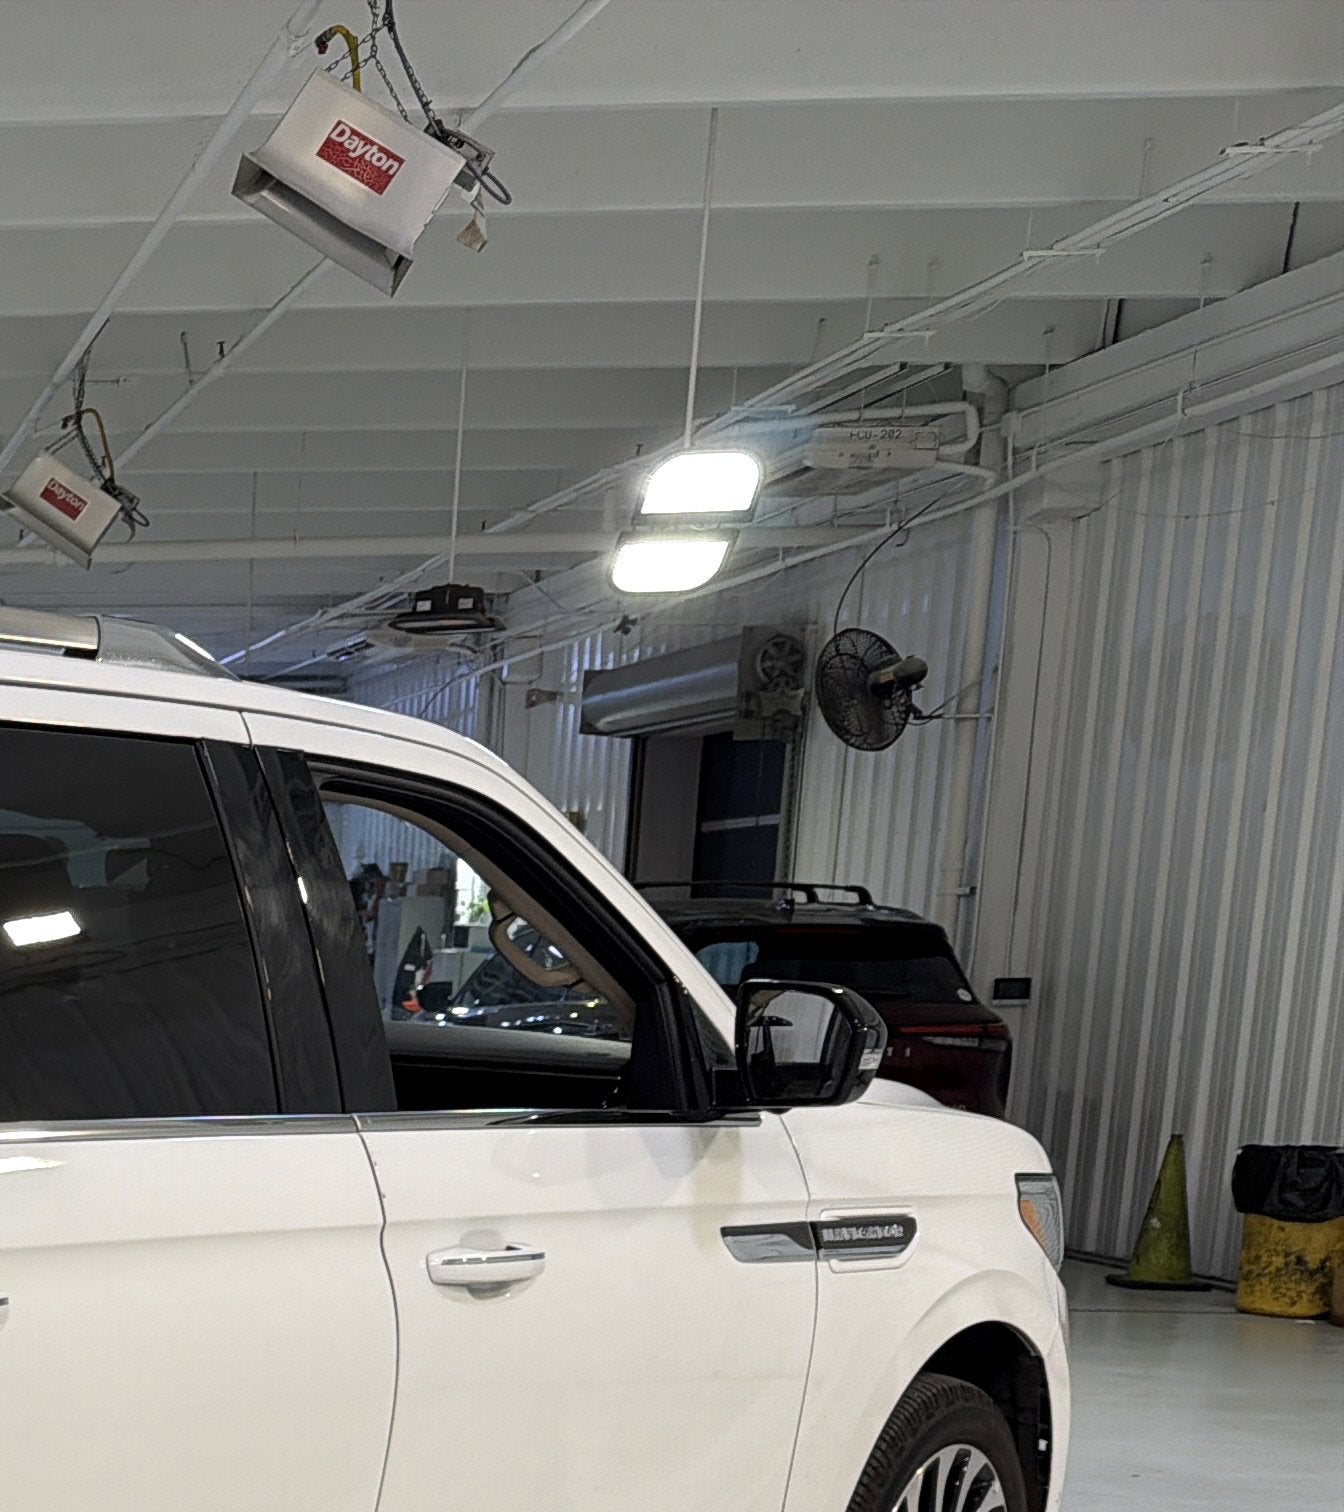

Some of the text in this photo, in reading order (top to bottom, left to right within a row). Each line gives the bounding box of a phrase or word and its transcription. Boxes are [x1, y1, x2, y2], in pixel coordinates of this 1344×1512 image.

[329, 123, 400, 176] Dayton
[849, 429, 904, 440] FCU-202
[47, 480, 85, 511] Dayton
